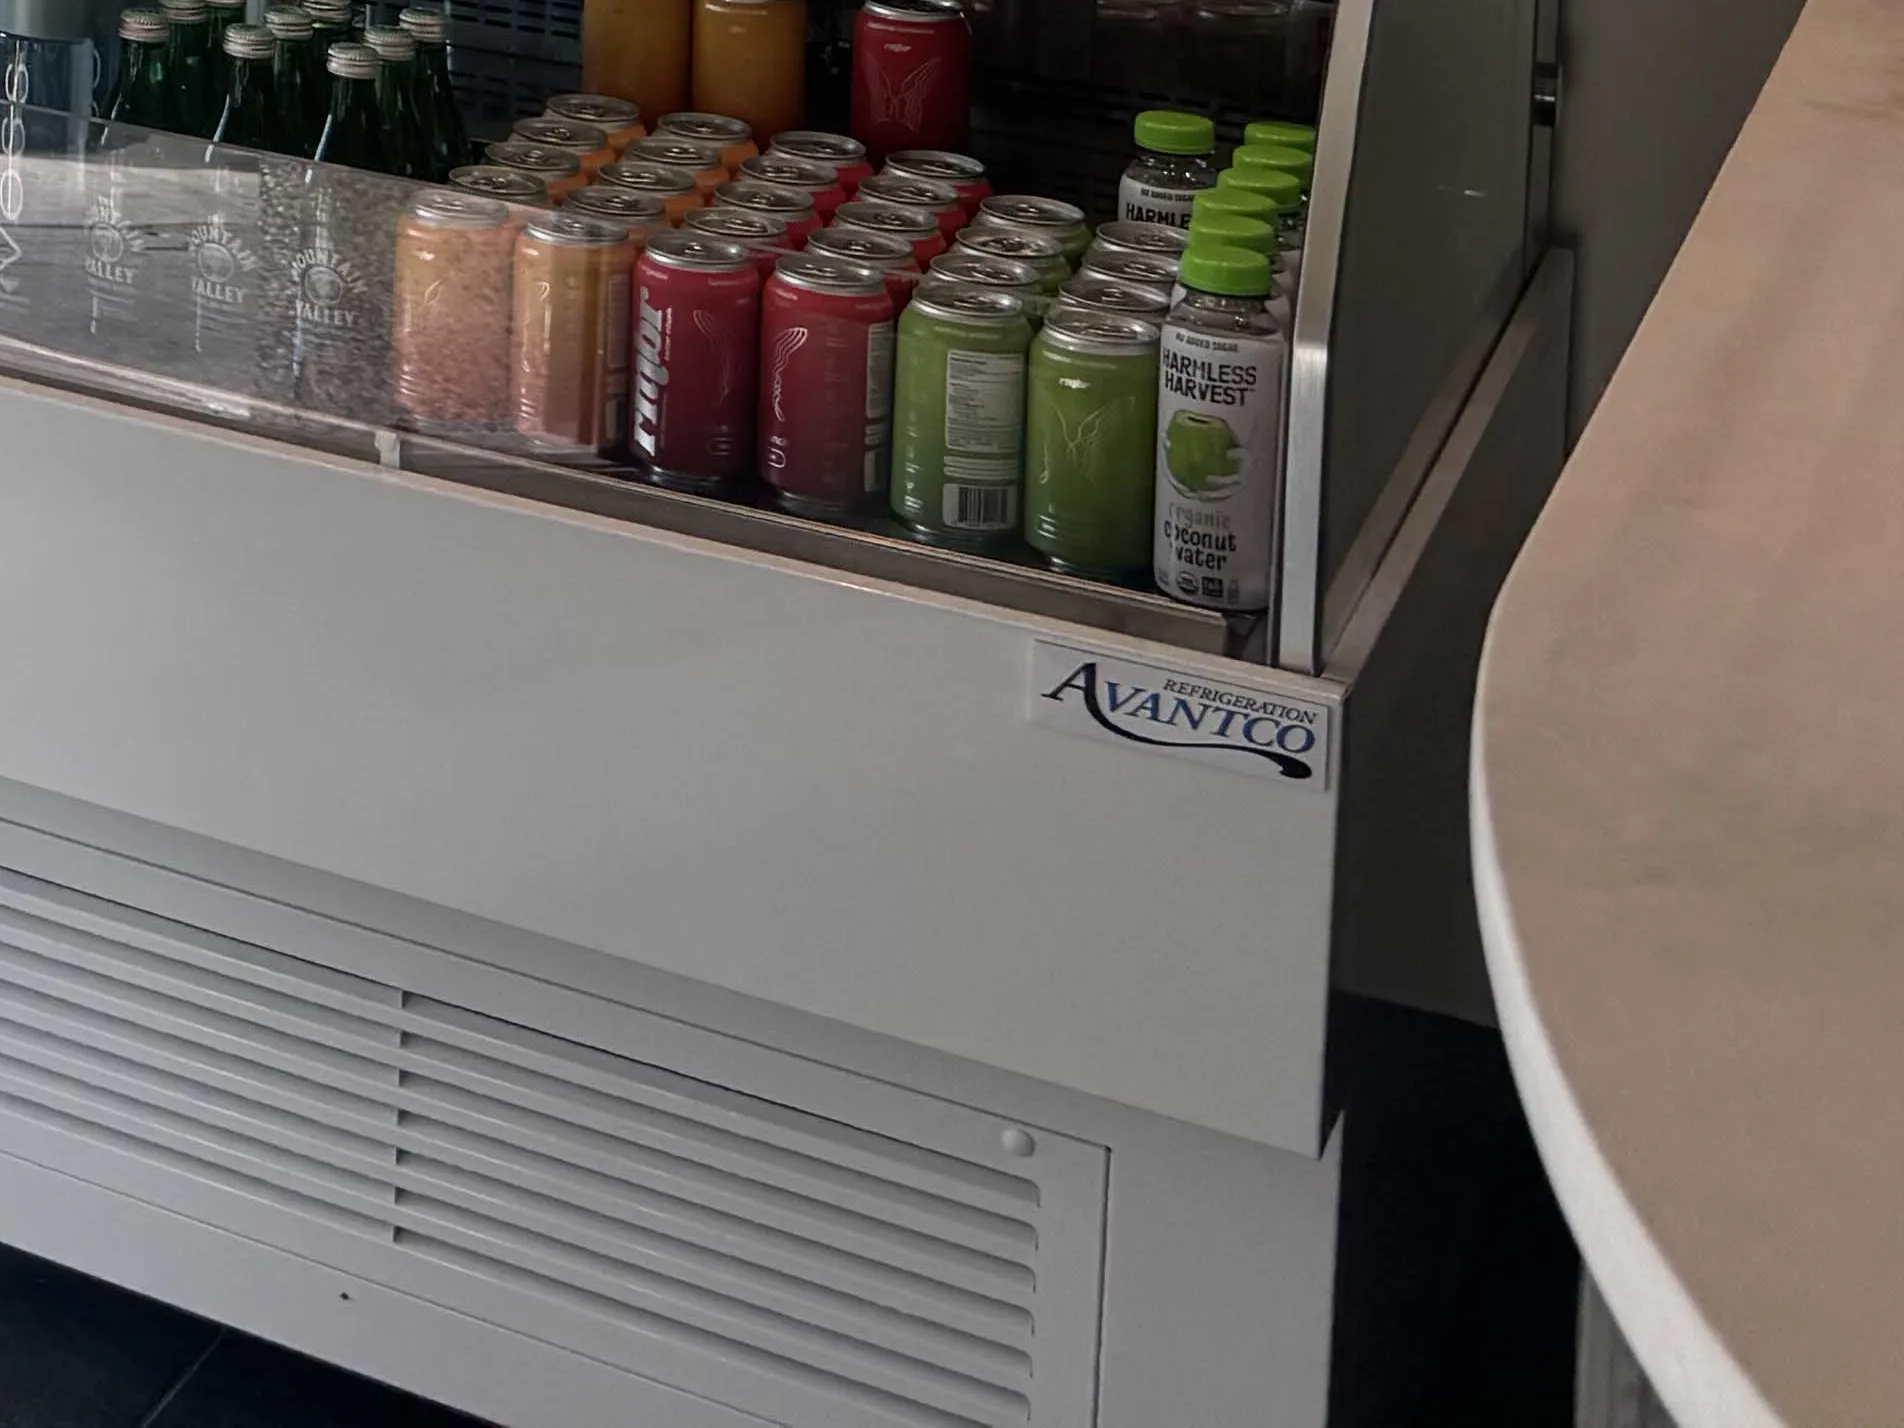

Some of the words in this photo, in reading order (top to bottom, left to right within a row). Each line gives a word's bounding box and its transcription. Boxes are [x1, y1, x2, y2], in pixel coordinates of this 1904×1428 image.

[1126, 202, 1192, 230] HARMLE
[1163, 347, 1258, 386] HARMLESS
[1164, 370, 1249, 407] HARVEST
[1041, 662, 1316, 779] AVANTCO
[1162, 678, 1319, 725] REFRIGERATION
